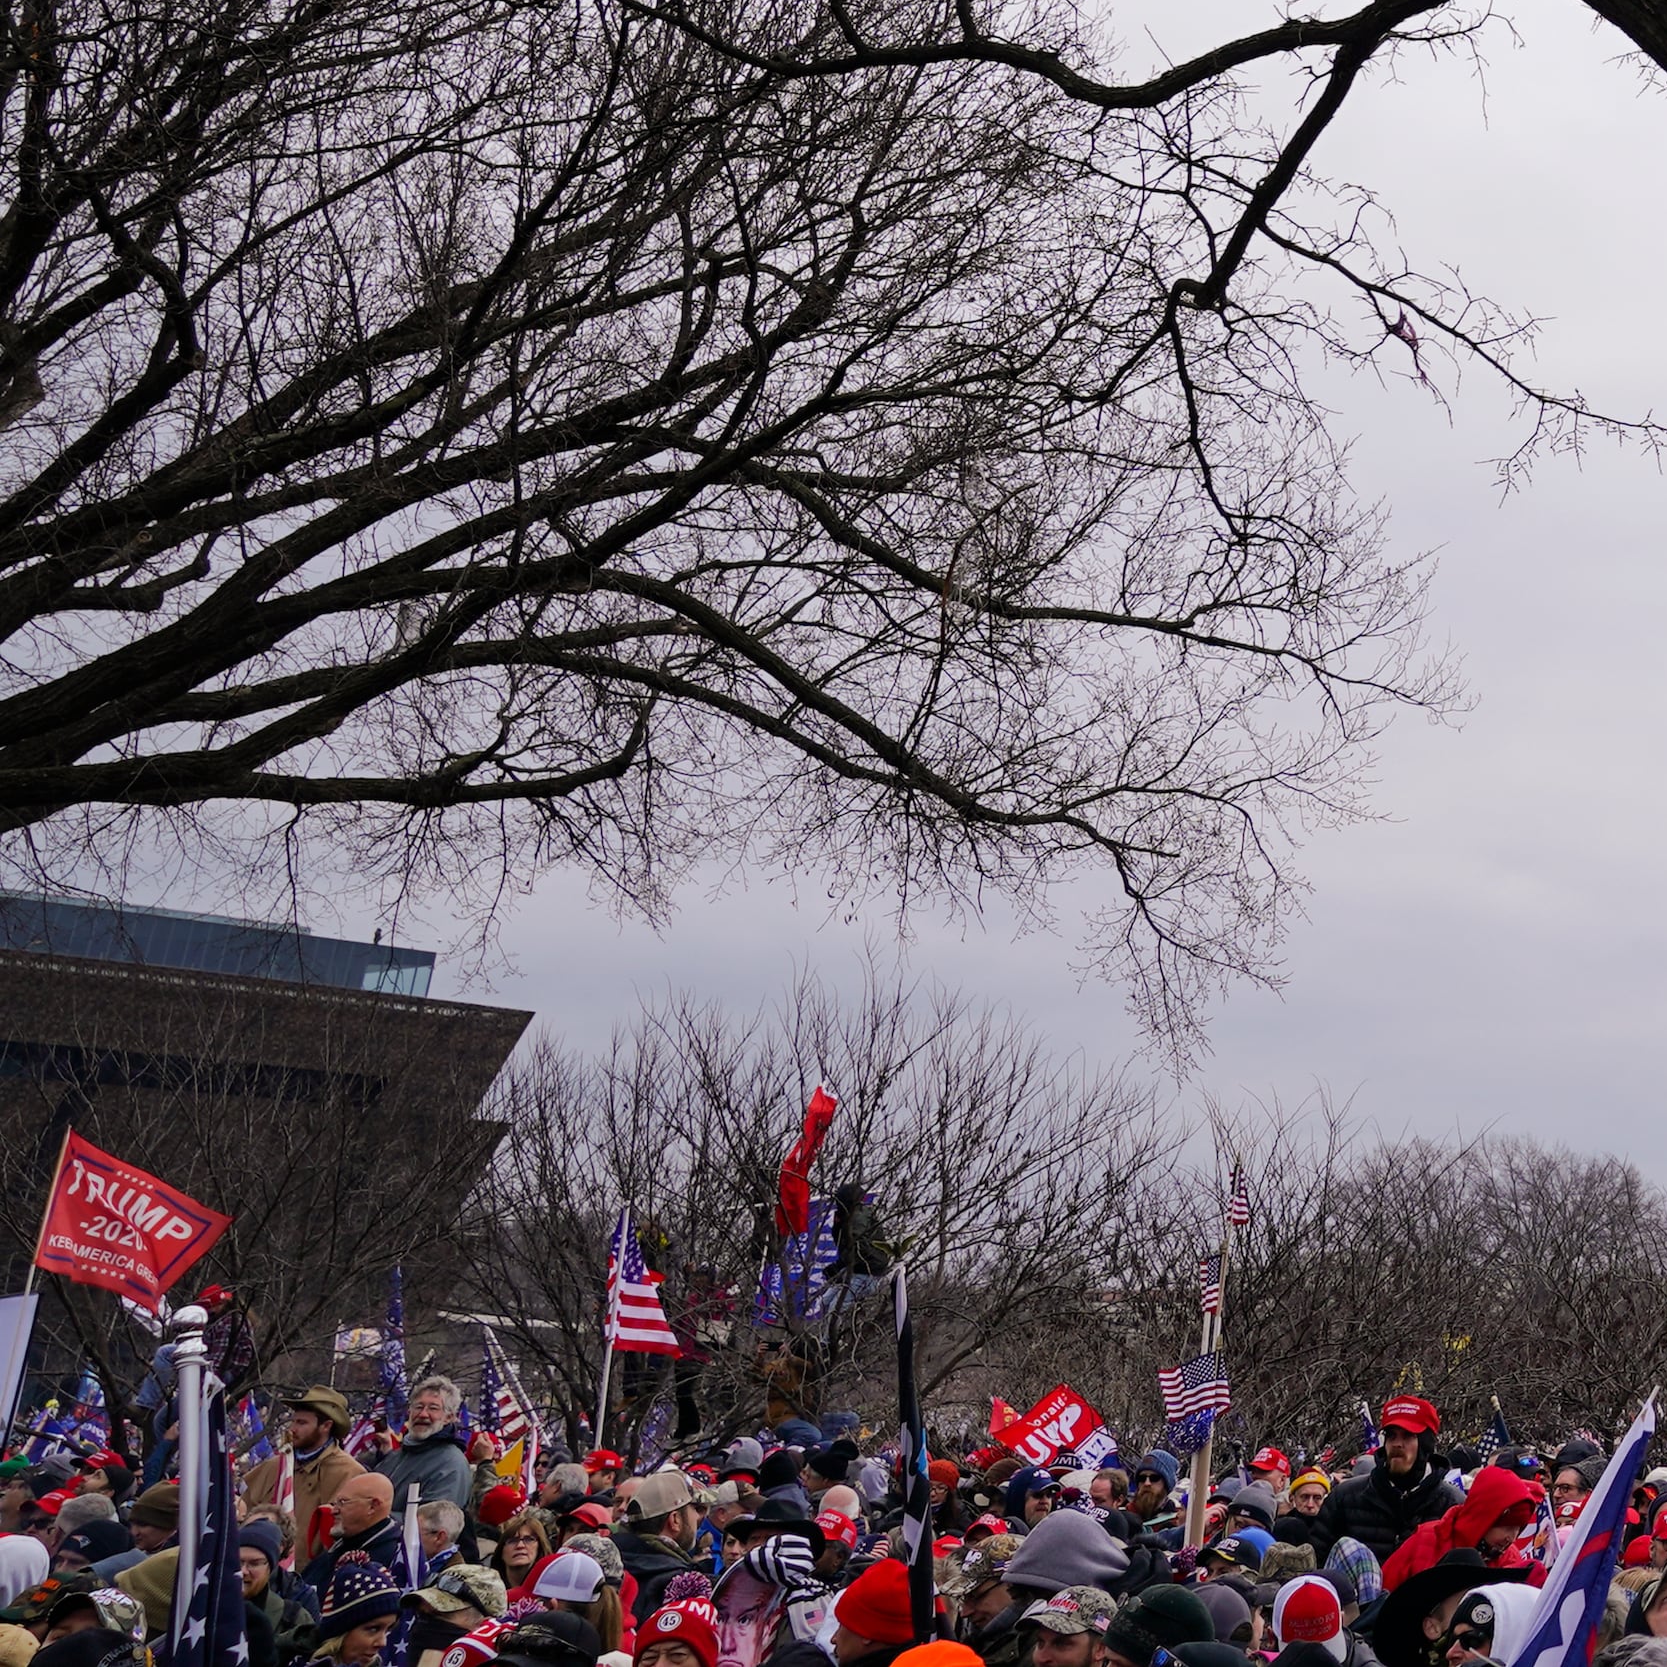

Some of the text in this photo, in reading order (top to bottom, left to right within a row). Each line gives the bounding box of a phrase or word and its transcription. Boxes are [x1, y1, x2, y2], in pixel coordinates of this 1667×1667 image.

[67, 1159, 193, 1241] TRUMP
[72, 1242, 135, 1272] AMERICA
[661, 1614, 678, 1628] 45
[445, 1650, 463, 1665] 45
